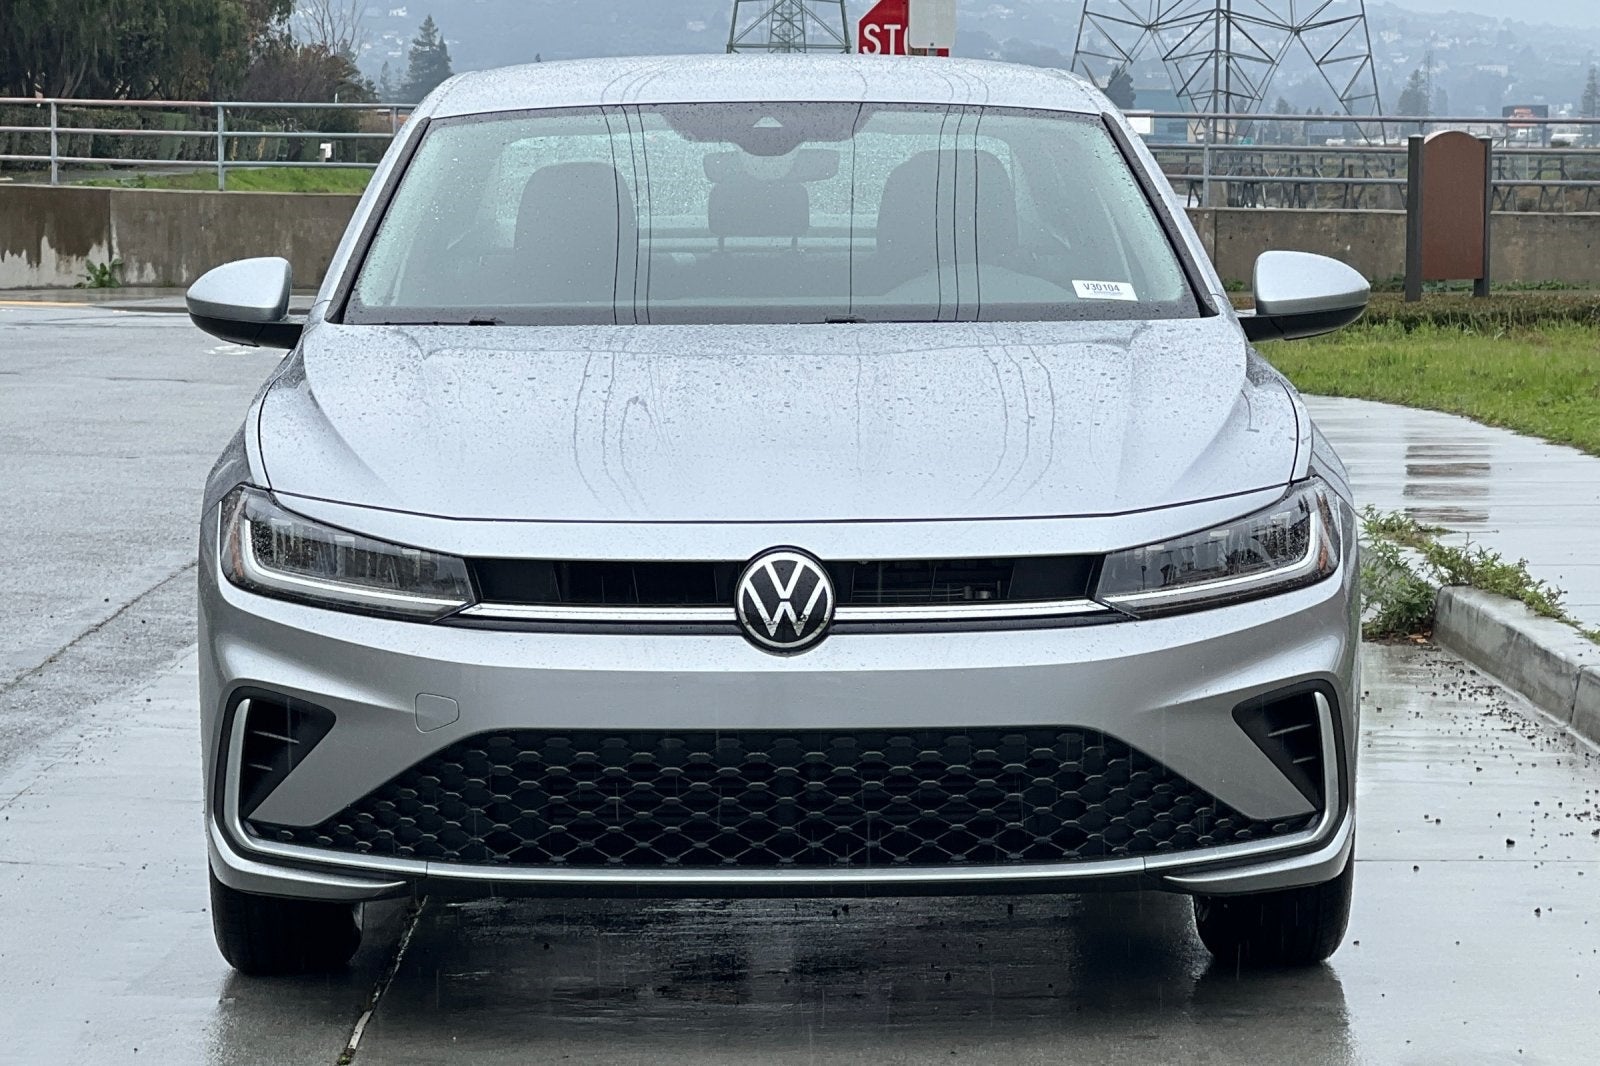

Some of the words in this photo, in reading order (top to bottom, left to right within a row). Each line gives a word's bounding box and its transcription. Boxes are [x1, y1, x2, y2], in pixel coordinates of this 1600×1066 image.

[862, 23, 909, 55] ST
[1083, 283, 1121, 292] V30104
[742, 556, 827, 638] VW
